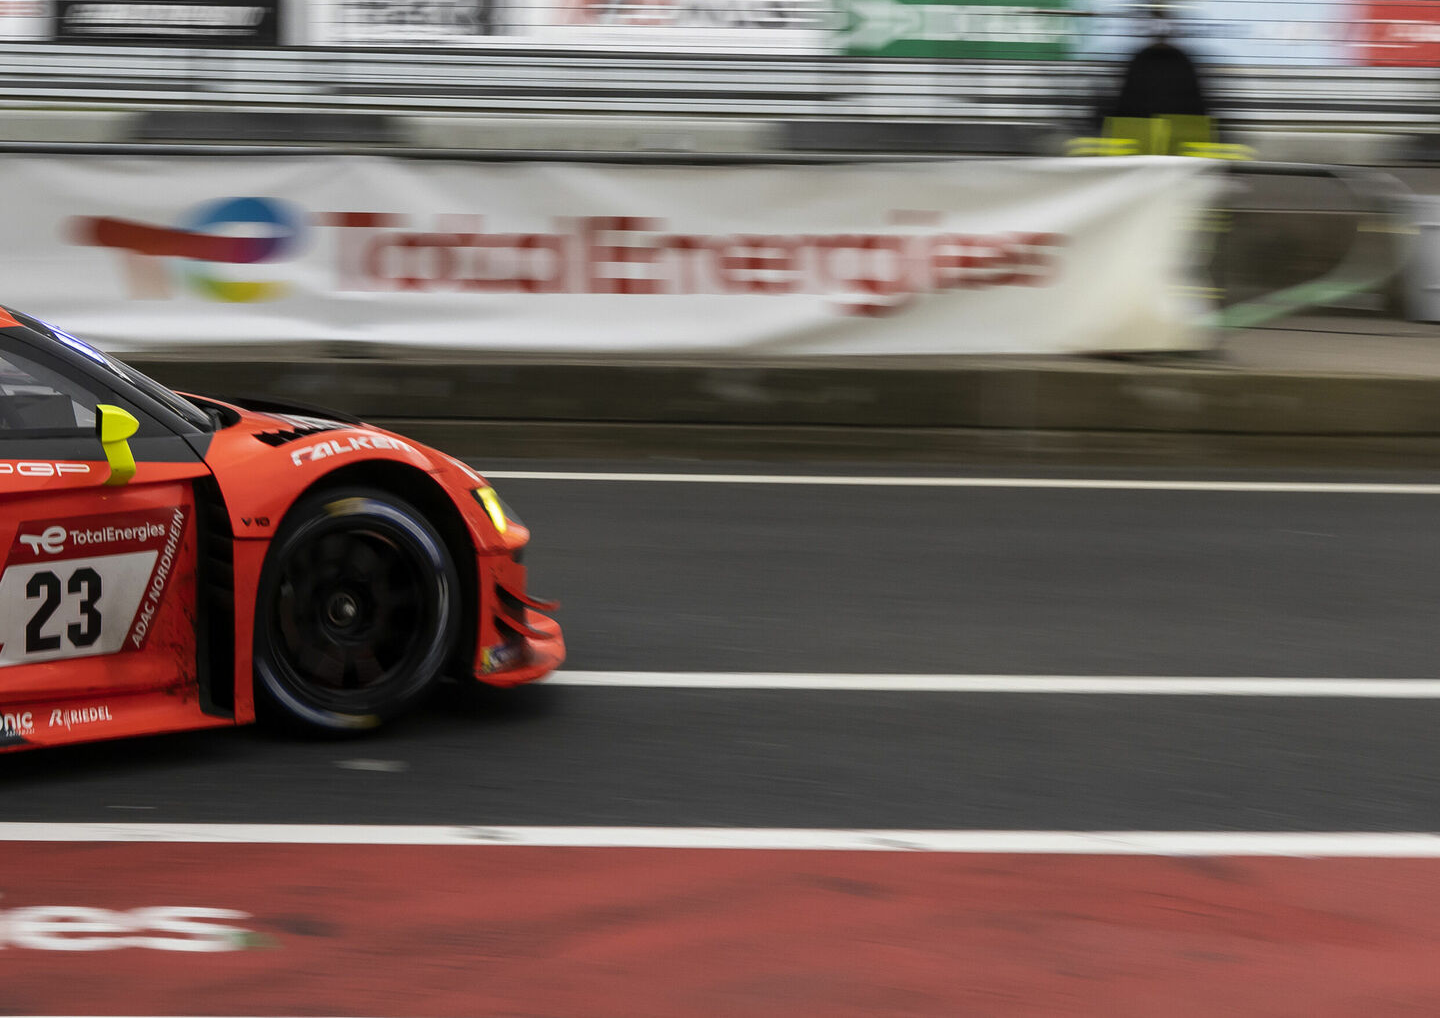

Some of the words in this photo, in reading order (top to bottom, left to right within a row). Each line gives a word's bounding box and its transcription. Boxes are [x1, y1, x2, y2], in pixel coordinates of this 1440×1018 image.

[312, 210, 1068, 318] TotalEnergies
[16, 461, 91, 477] GP
[290, 436, 411, 467] FALKEN
[69, 521, 166, 546] TotalEnergies
[132, 601, 155, 649] ADAC
[151, 508, 185, 604] NORDRHEIN
[25, 566, 103, 655] 23
